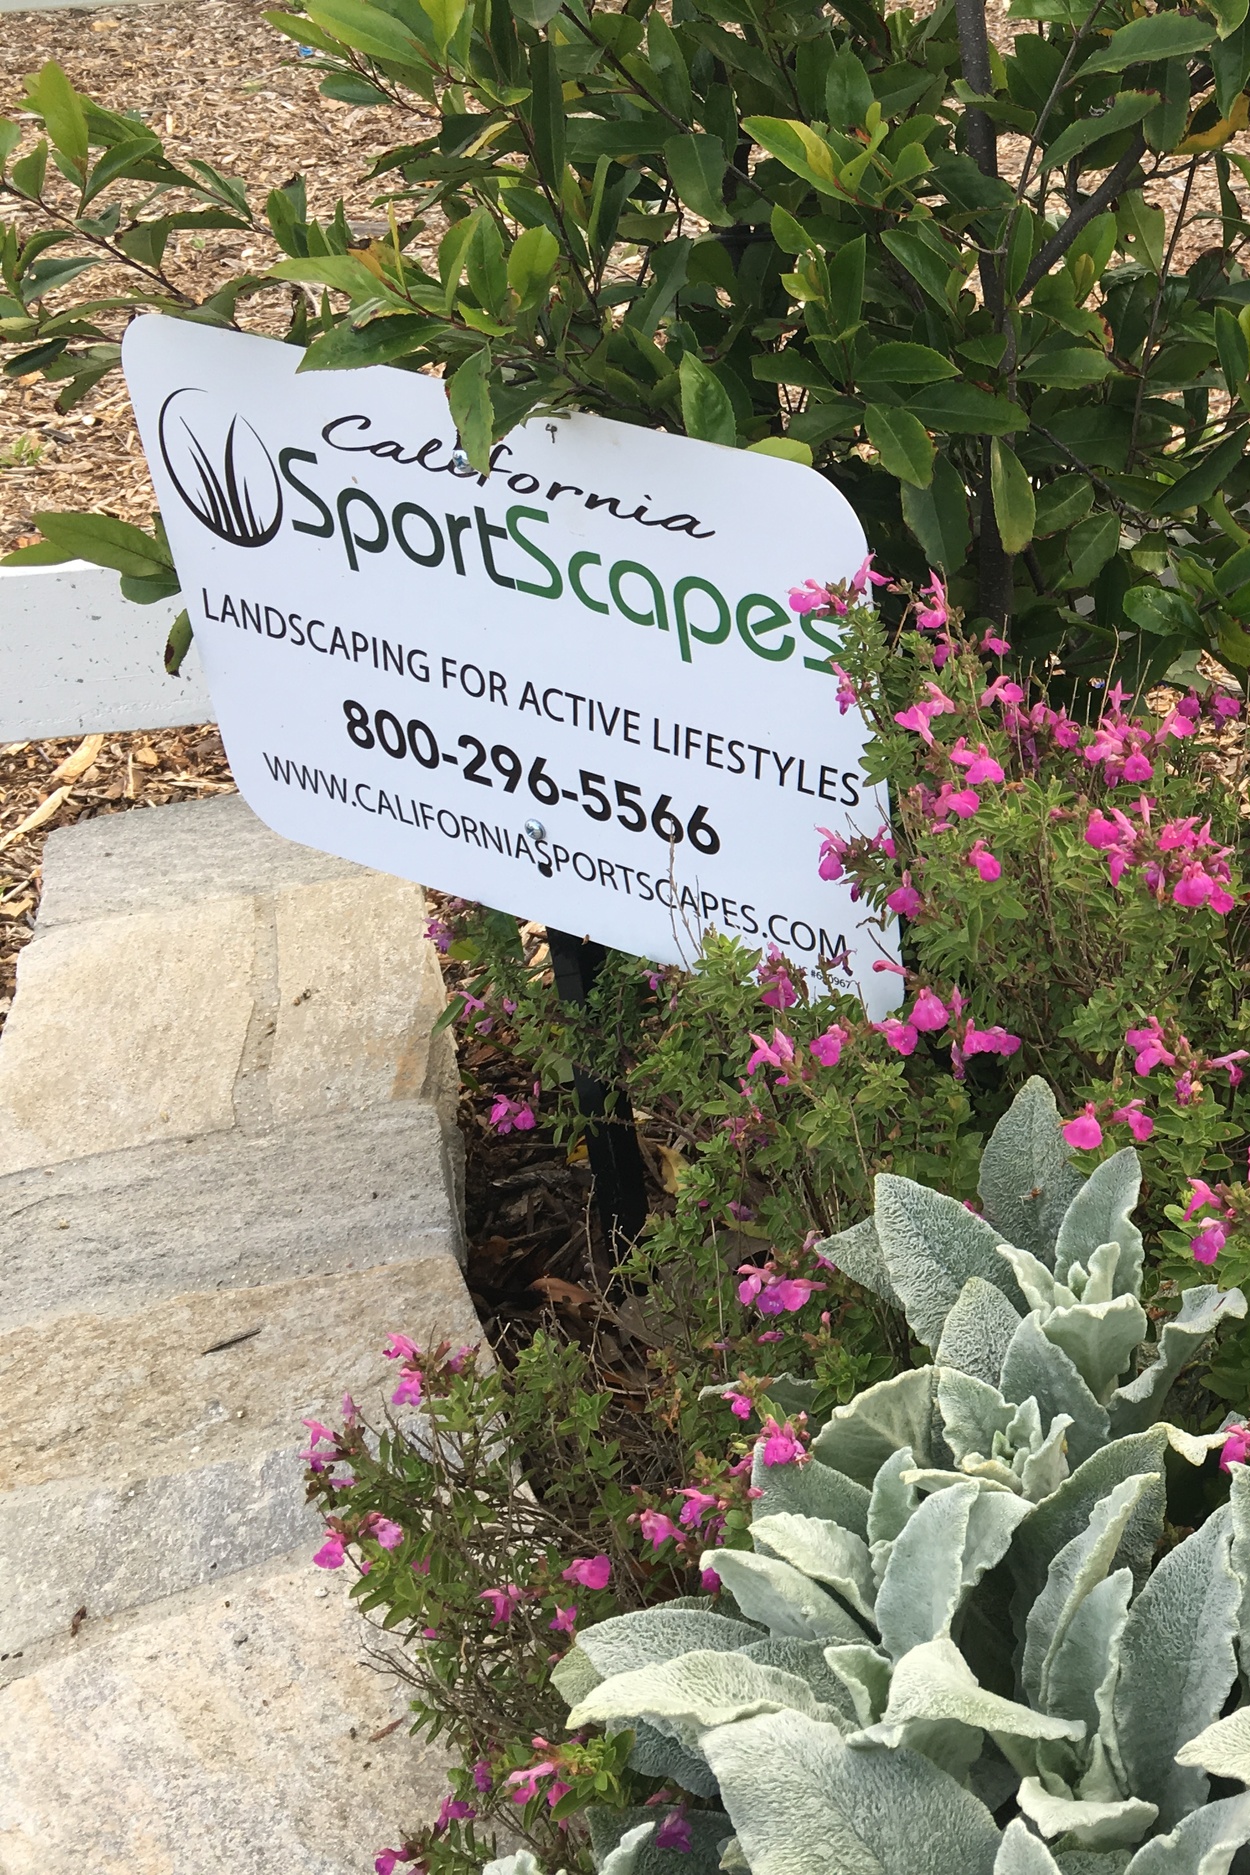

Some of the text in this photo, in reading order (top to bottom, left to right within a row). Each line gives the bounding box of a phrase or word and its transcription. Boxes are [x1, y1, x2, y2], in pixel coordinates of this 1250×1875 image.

[278, 447, 847, 676] SportScapes
[202, 587, 861, 807] LANDSCAPING FOR ACTIVE LIFESTYLES
[343, 699, 721, 856] 800-296-5566
[262, 752, 848, 960] WWW.CALIFORNIASPORTSCAPES.COM
[811, 970, 851, 989] #60967
